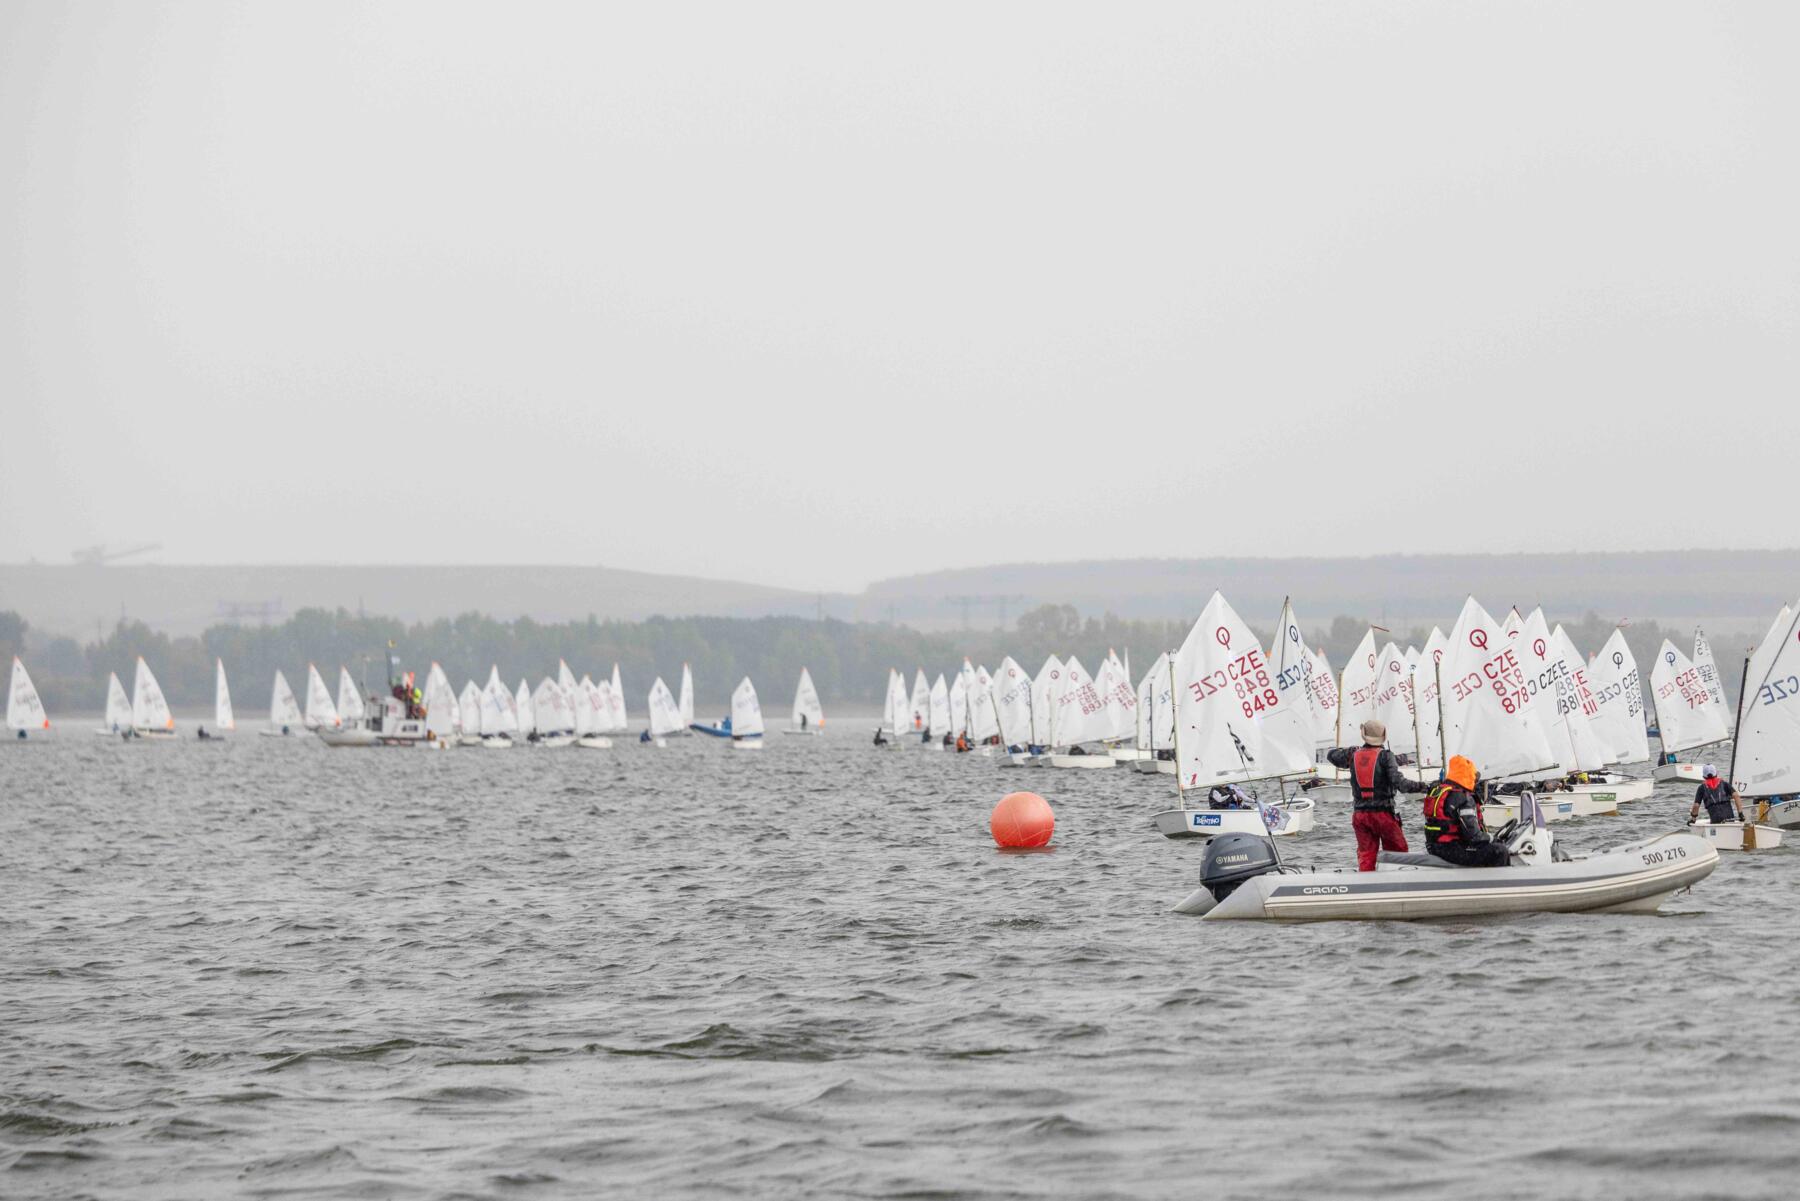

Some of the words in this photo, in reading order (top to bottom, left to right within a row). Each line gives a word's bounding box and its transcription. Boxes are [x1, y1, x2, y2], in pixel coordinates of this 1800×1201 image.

[1227, 650, 1263, 680] CZE
[1483, 649, 1519, 679] CZE
[1622, 669, 1638, 690] CZE
[1676, 668, 1697, 687] CZE
[1242, 688, 1279, 719] 848
[1501, 686, 1529, 714] 878
[1686, 690, 1709, 710] 728
[1223, 853, 1249, 864] YAMAHA
[1642, 852, 1664, 866] 500
[1664, 846, 1686, 861] 276
[1303, 885, 1349, 895] GRAND
